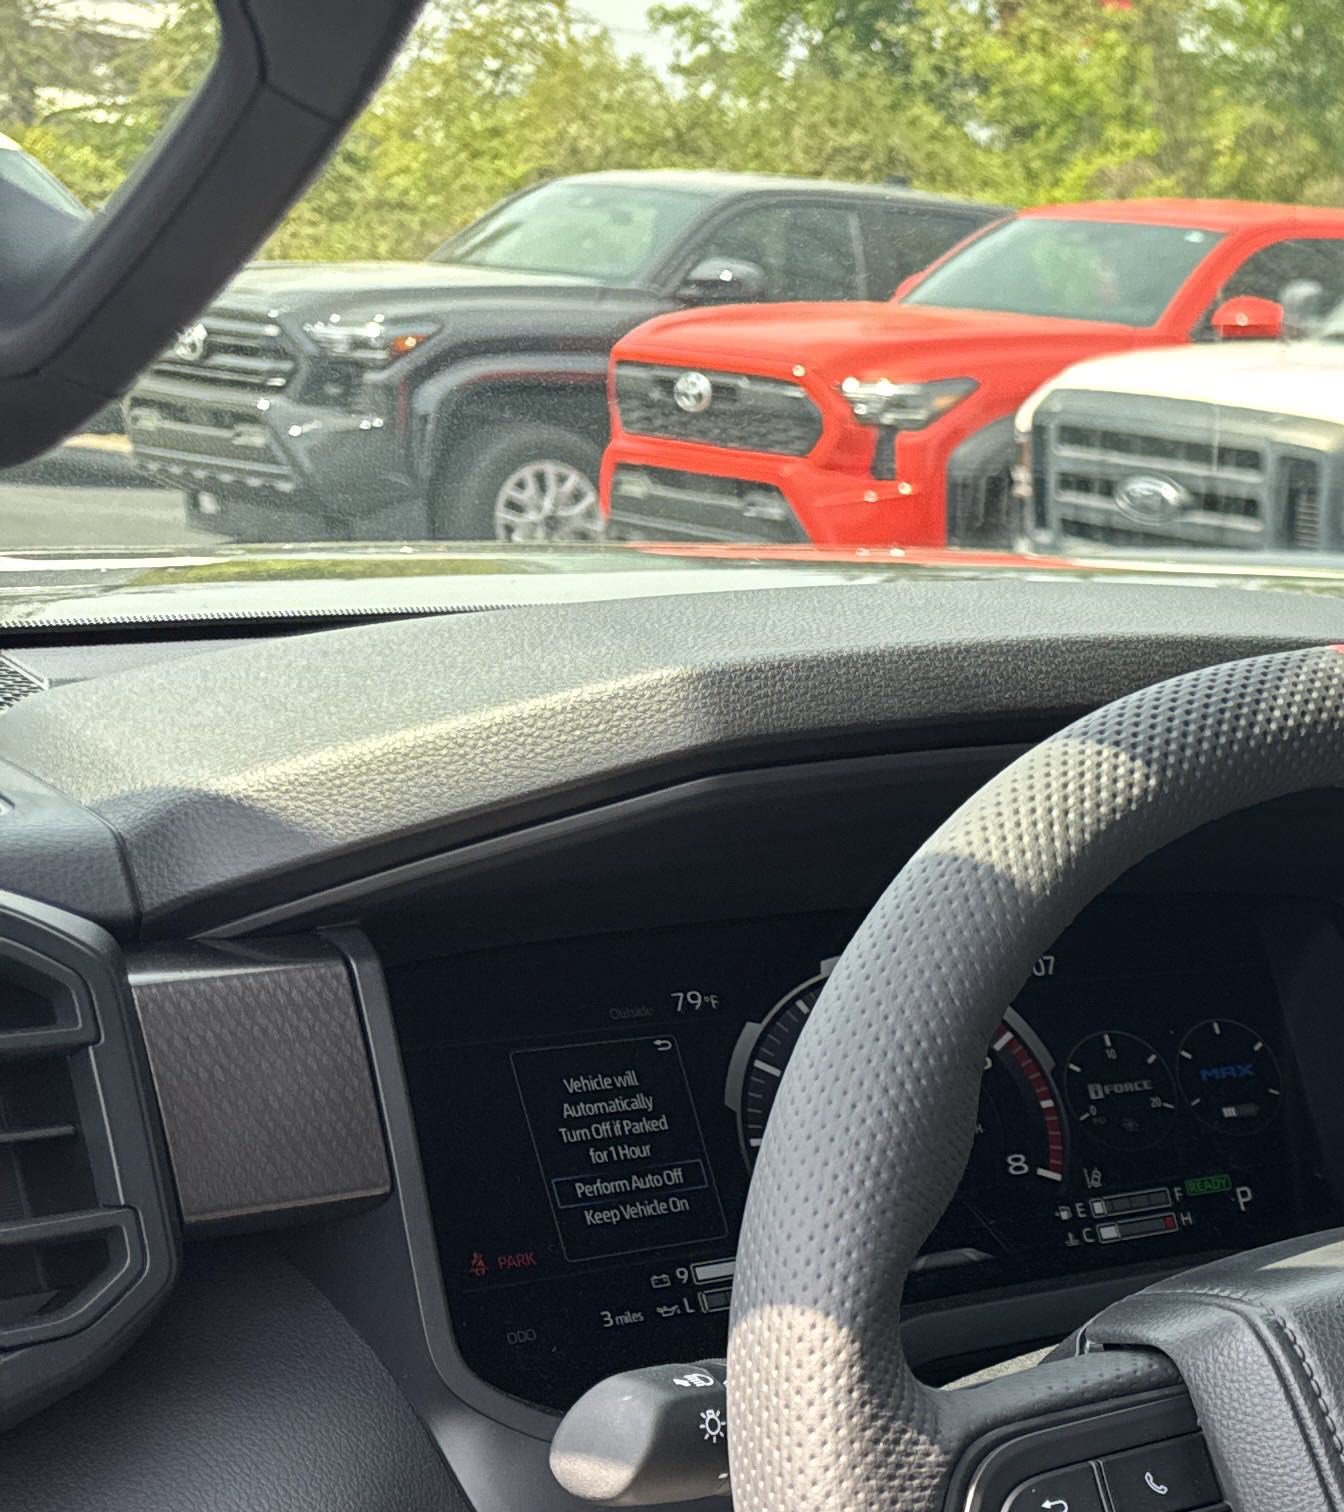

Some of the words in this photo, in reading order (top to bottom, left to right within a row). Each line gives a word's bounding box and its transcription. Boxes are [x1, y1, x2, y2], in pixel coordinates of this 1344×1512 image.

[562, 1073, 613, 1094] Vehicle
[613, 1069, 640, 1089] will
[1200, 1063, 1256, 1081] MAX
[562, 1092, 654, 1120] Automatically
[558, 1127, 591, 1144] Turn
[590, 1119, 613, 1140] Off
[613, 1119, 623, 1137] if
[623, 1114, 670, 1136] Parked
[589, 1147, 609, 1165] for
[608, 1145, 618, 1161] 1
[618, 1143, 652, 1161] Hour
[1006, 1153, 1030, 1176] 8
[574, 1178, 631, 1199] Perform
[631, 1174, 663, 1191] Auto
[662, 1168, 685, 1186] Off
[1187, 1176, 1230, 1193] READY
[584, 1208, 621, 1227] Keep
[620, 1199, 669, 1220] Vehicle
[668, 1196, 690, 1213] On
[1075, 1202, 1088, 1219] E
[1180, 1212, 1194, 1227] H
[1082, 1227, 1096, 1244] C
[496, 1252, 537, 1270] PARK
[600, 1310, 614, 1328] 3
[614, 1309, 645, 1326] miles
